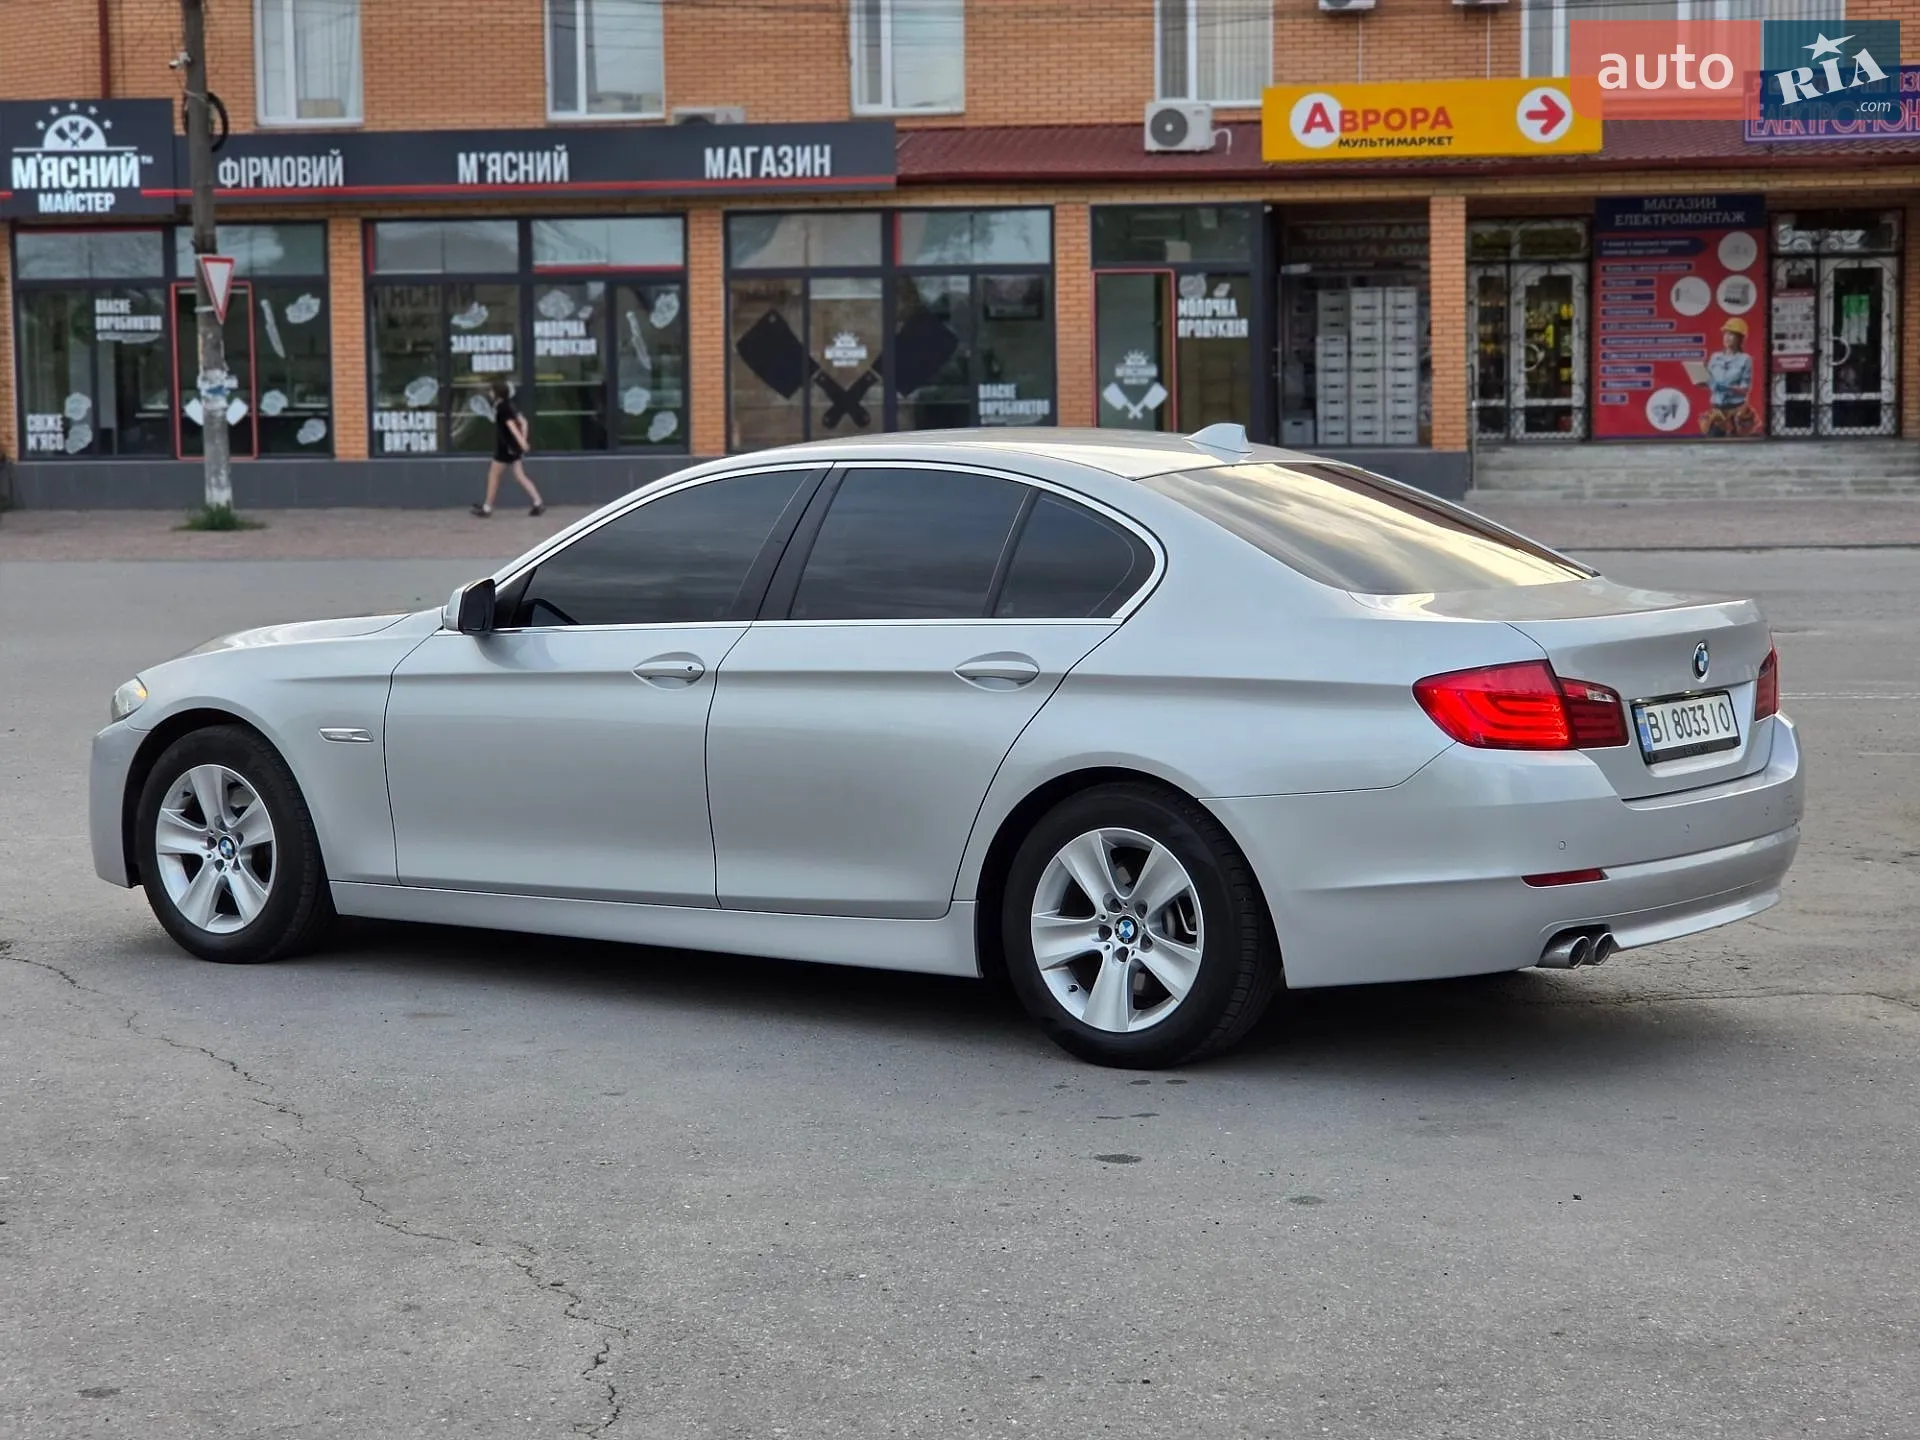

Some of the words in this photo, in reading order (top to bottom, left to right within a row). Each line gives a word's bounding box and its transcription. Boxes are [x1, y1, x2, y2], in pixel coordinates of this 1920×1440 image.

[1301, 102, 1454, 135] АВРОРА
[1338, 136, 1454, 149] МУЛЬТИМАРКЕТ
[11, 152, 140, 190] М'ЯСНИЙ
[217, 149, 344, 189] ФІРМОВИЙ
[457, 145, 570, 185] М'ЯСНИЙ
[704, 144, 832, 180] МАГАЗИН
[38, 190, 116, 213] МАЙСТЕР
[1643, 197, 1717, 211] МАГАЗИН
[1614, 211, 1746, 227] ЕЛЕКТРОМОНТАЖ
[1646, 710, 1671, 743] BI
[1671, 704, 1710, 739] 8033
